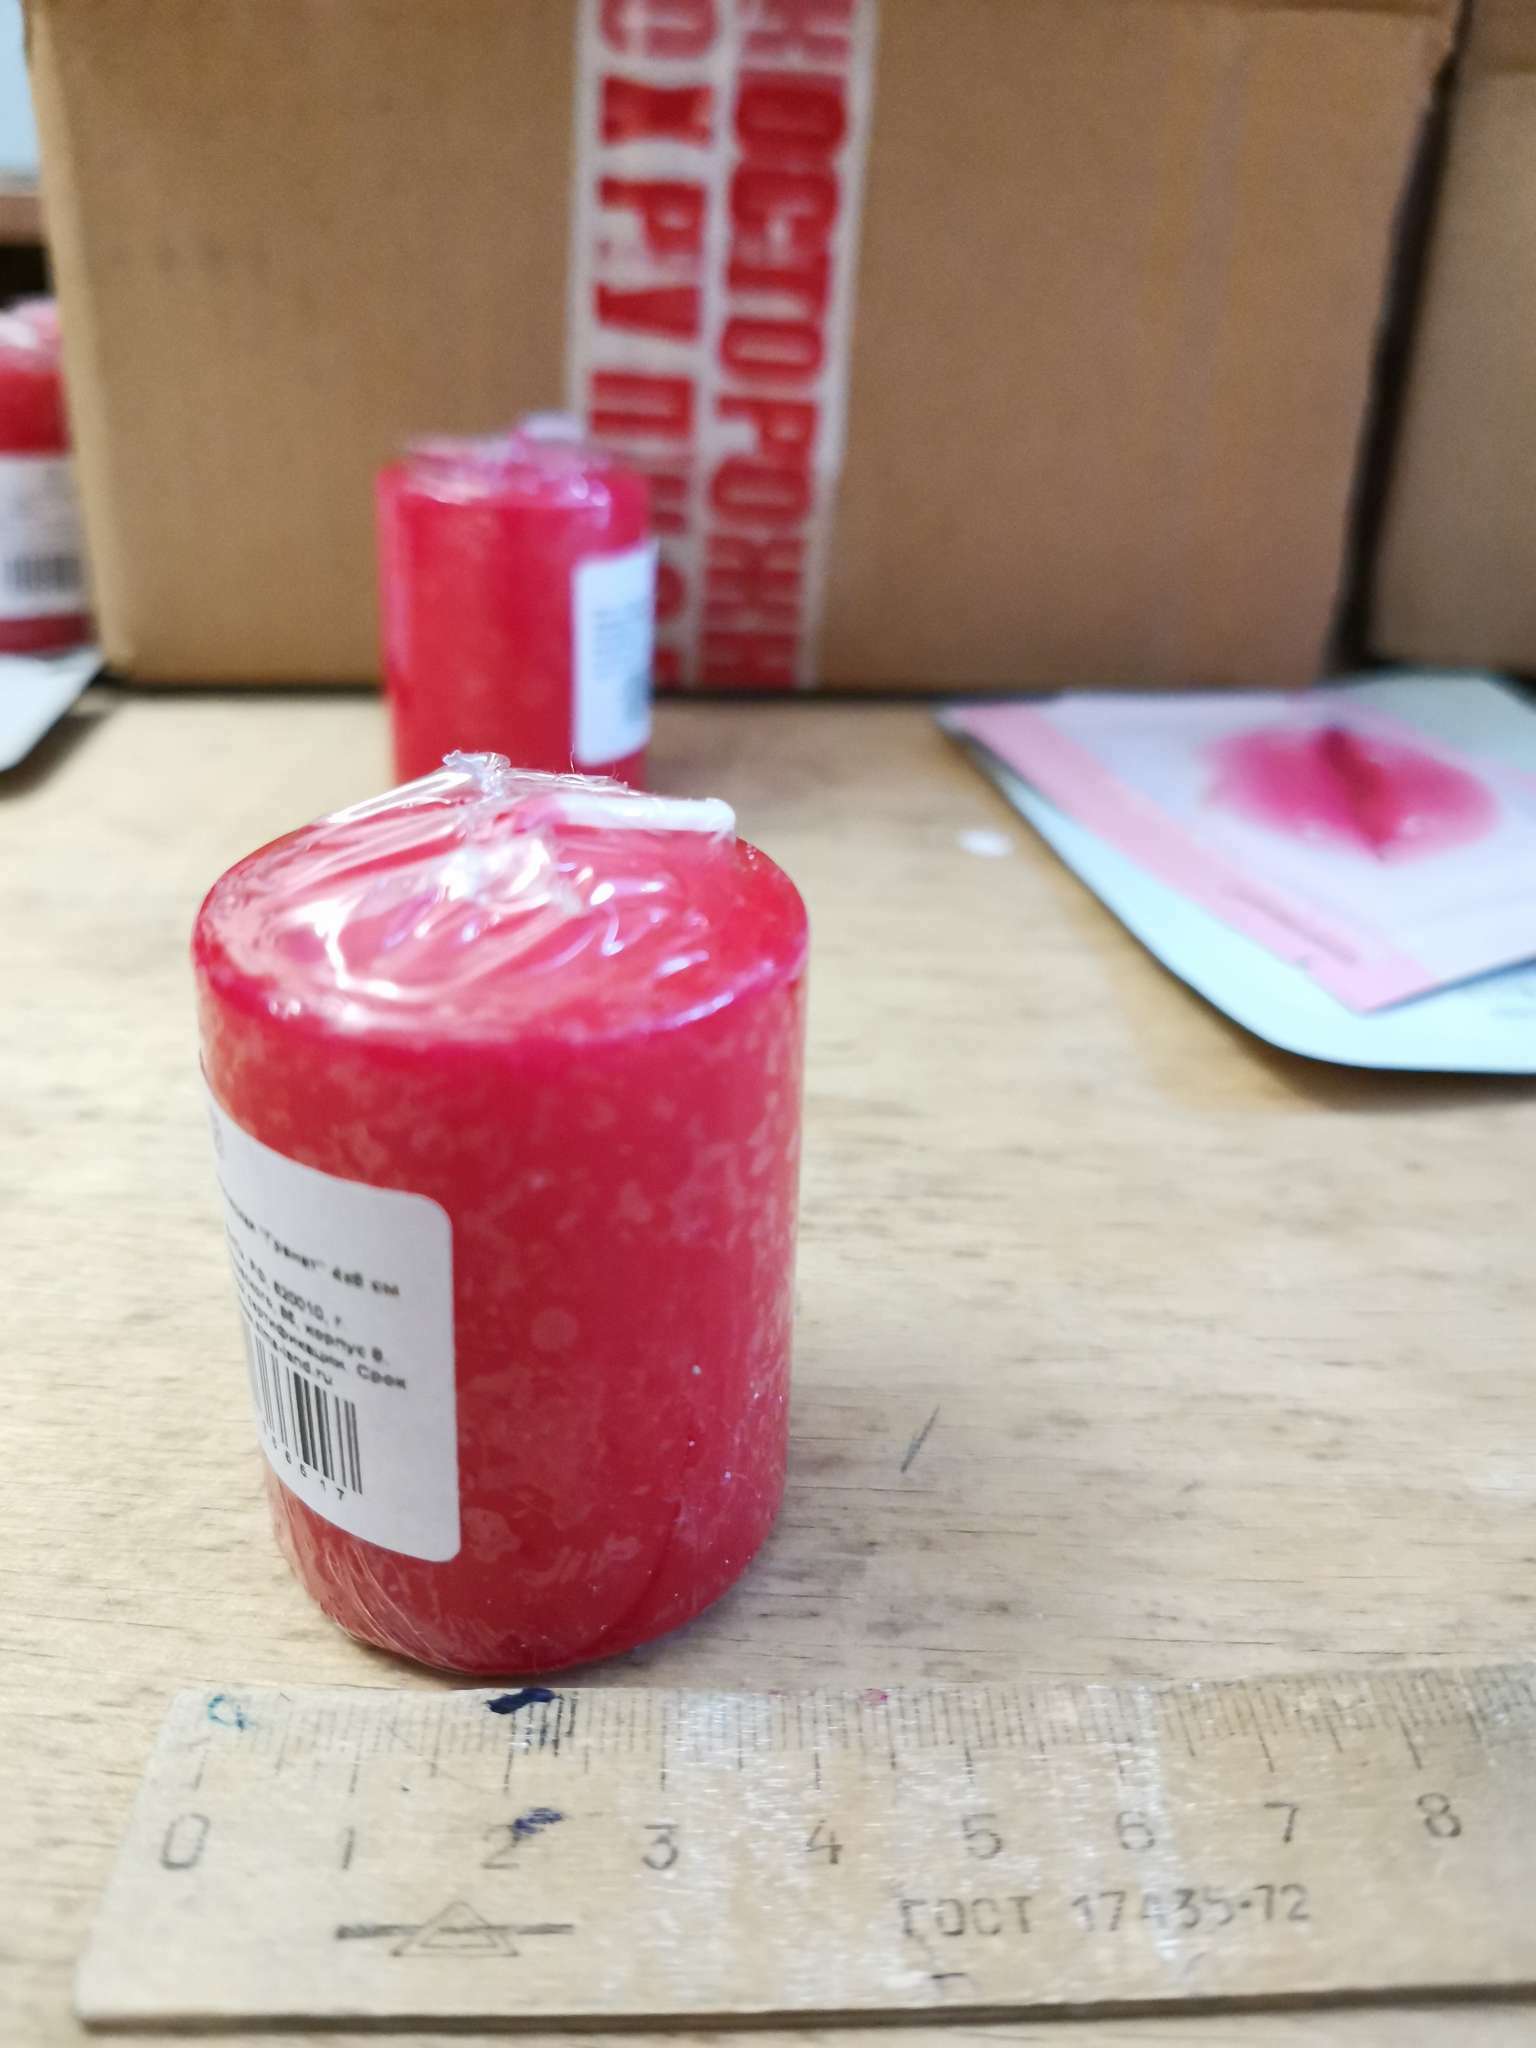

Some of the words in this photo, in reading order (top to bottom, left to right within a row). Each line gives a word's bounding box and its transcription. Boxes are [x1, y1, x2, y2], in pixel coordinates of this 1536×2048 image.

[160, 1813, 210, 1870] 0
[340, 1827, 356, 1871] 1
[481, 1824, 521, 1870] 2
[640, 1823, 681, 1871] 3
[804, 1818, 843, 1865] 4
[961, 1812, 1002, 1861] 5
[1114, 1810, 1157, 1851] 6
[1262, 1802, 1300, 1844] 7
[1415, 1792, 1463, 1840] 8
[901, 1894, 1034, 1938] ГОСТ
